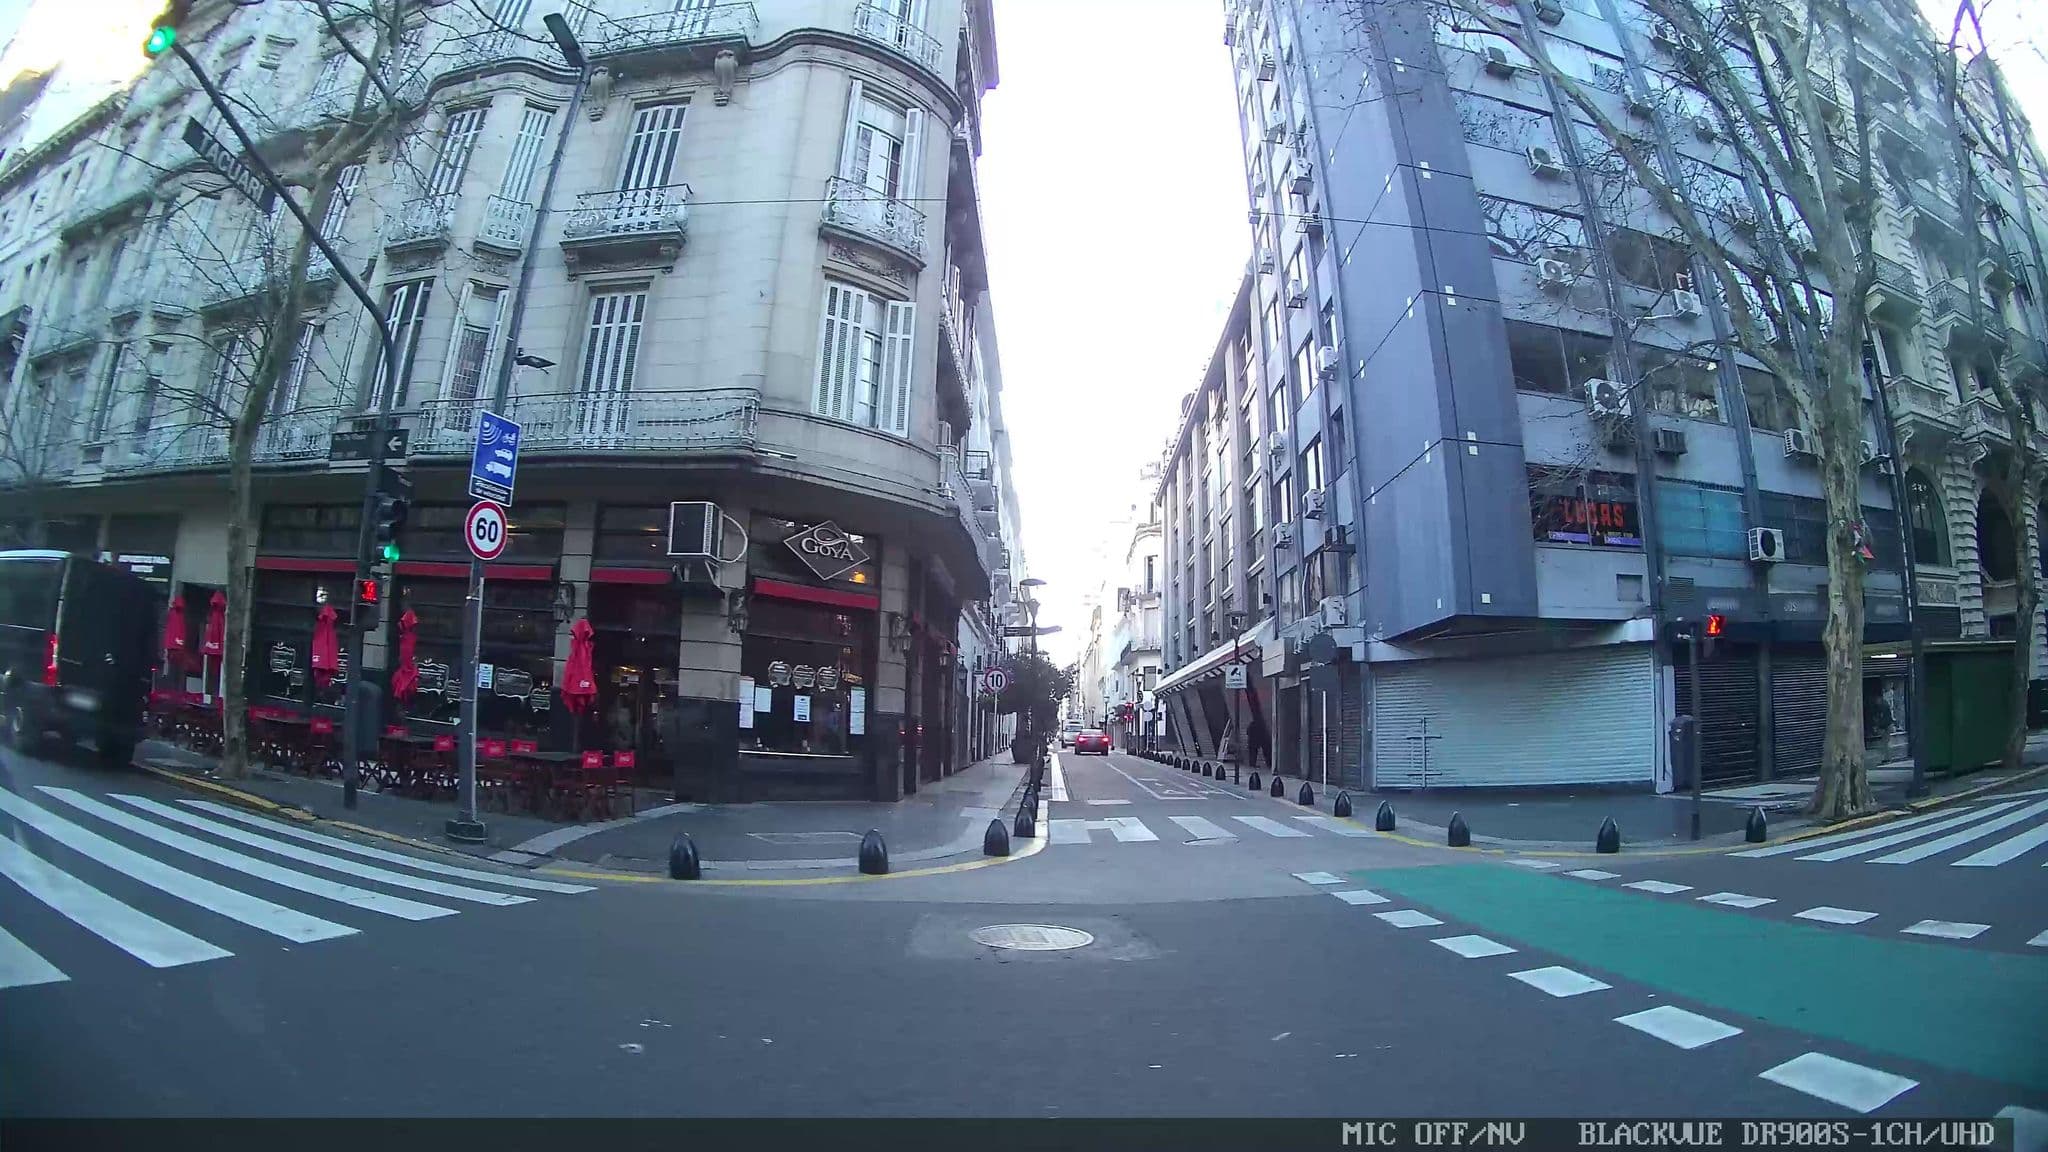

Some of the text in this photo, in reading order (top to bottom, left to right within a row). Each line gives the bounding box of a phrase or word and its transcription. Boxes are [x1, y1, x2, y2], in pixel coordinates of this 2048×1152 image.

[476, 517, 498, 543] 60
[801, 537, 855, 561] GOYA
[990, 673, 1003, 689] 10
